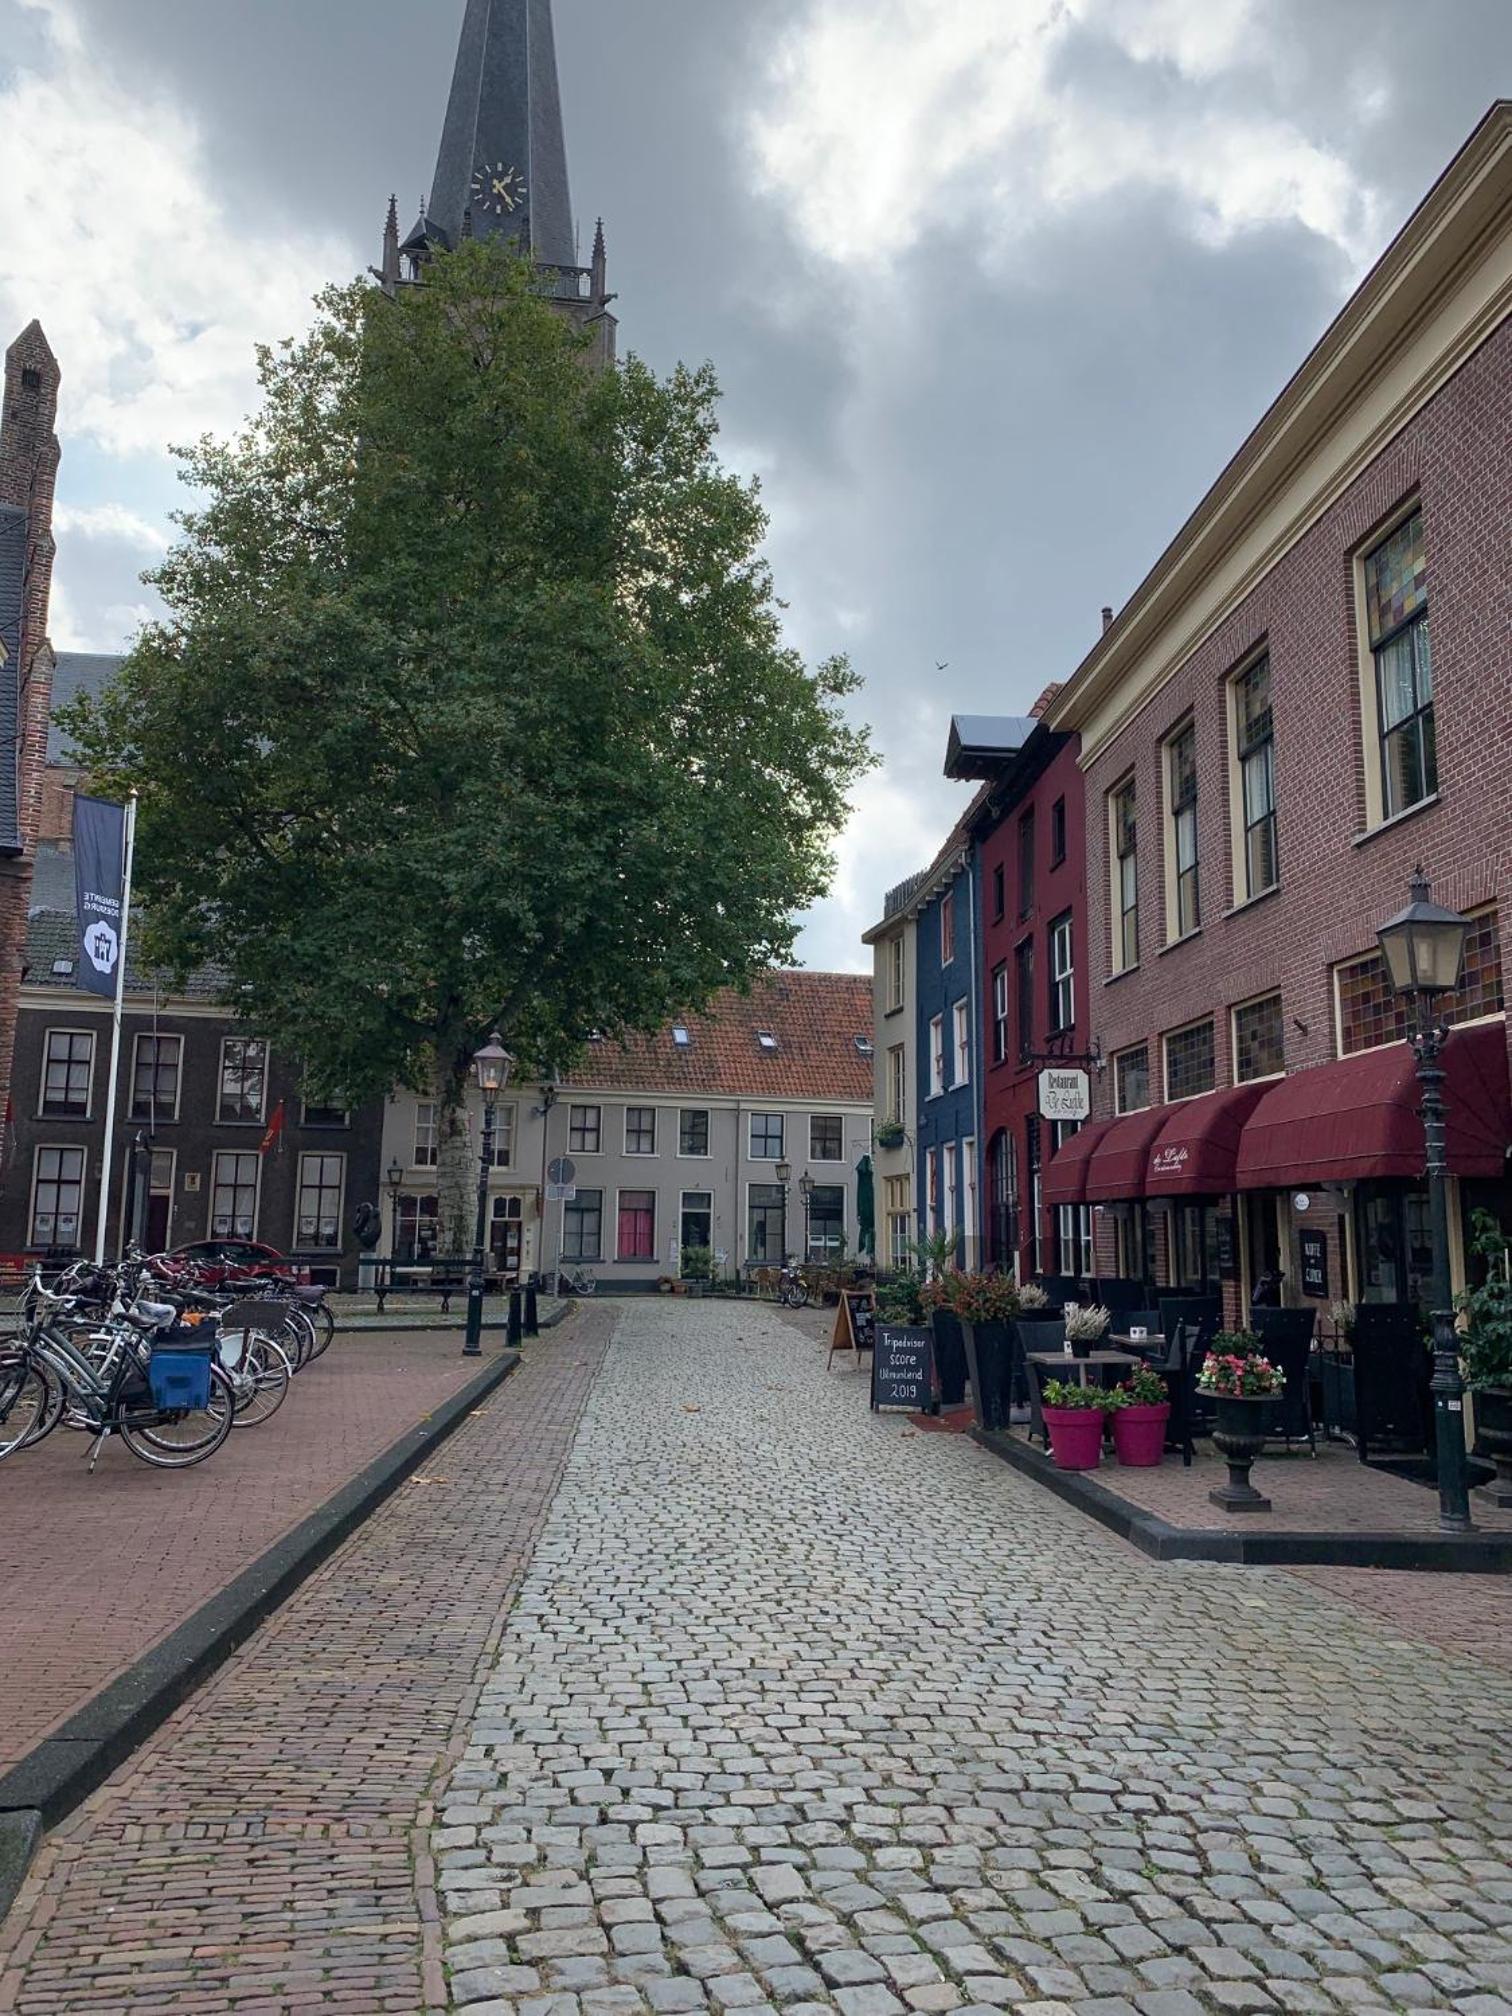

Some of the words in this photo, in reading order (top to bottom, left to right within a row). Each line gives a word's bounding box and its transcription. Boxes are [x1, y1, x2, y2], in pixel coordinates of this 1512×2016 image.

[1048, 1072, 1079, 1089] Restaurant
[883, 1333, 925, 1352] Tripadvisor
[890, 1354, 916, 1365] score
[890, 1384, 916, 1398] 2019
